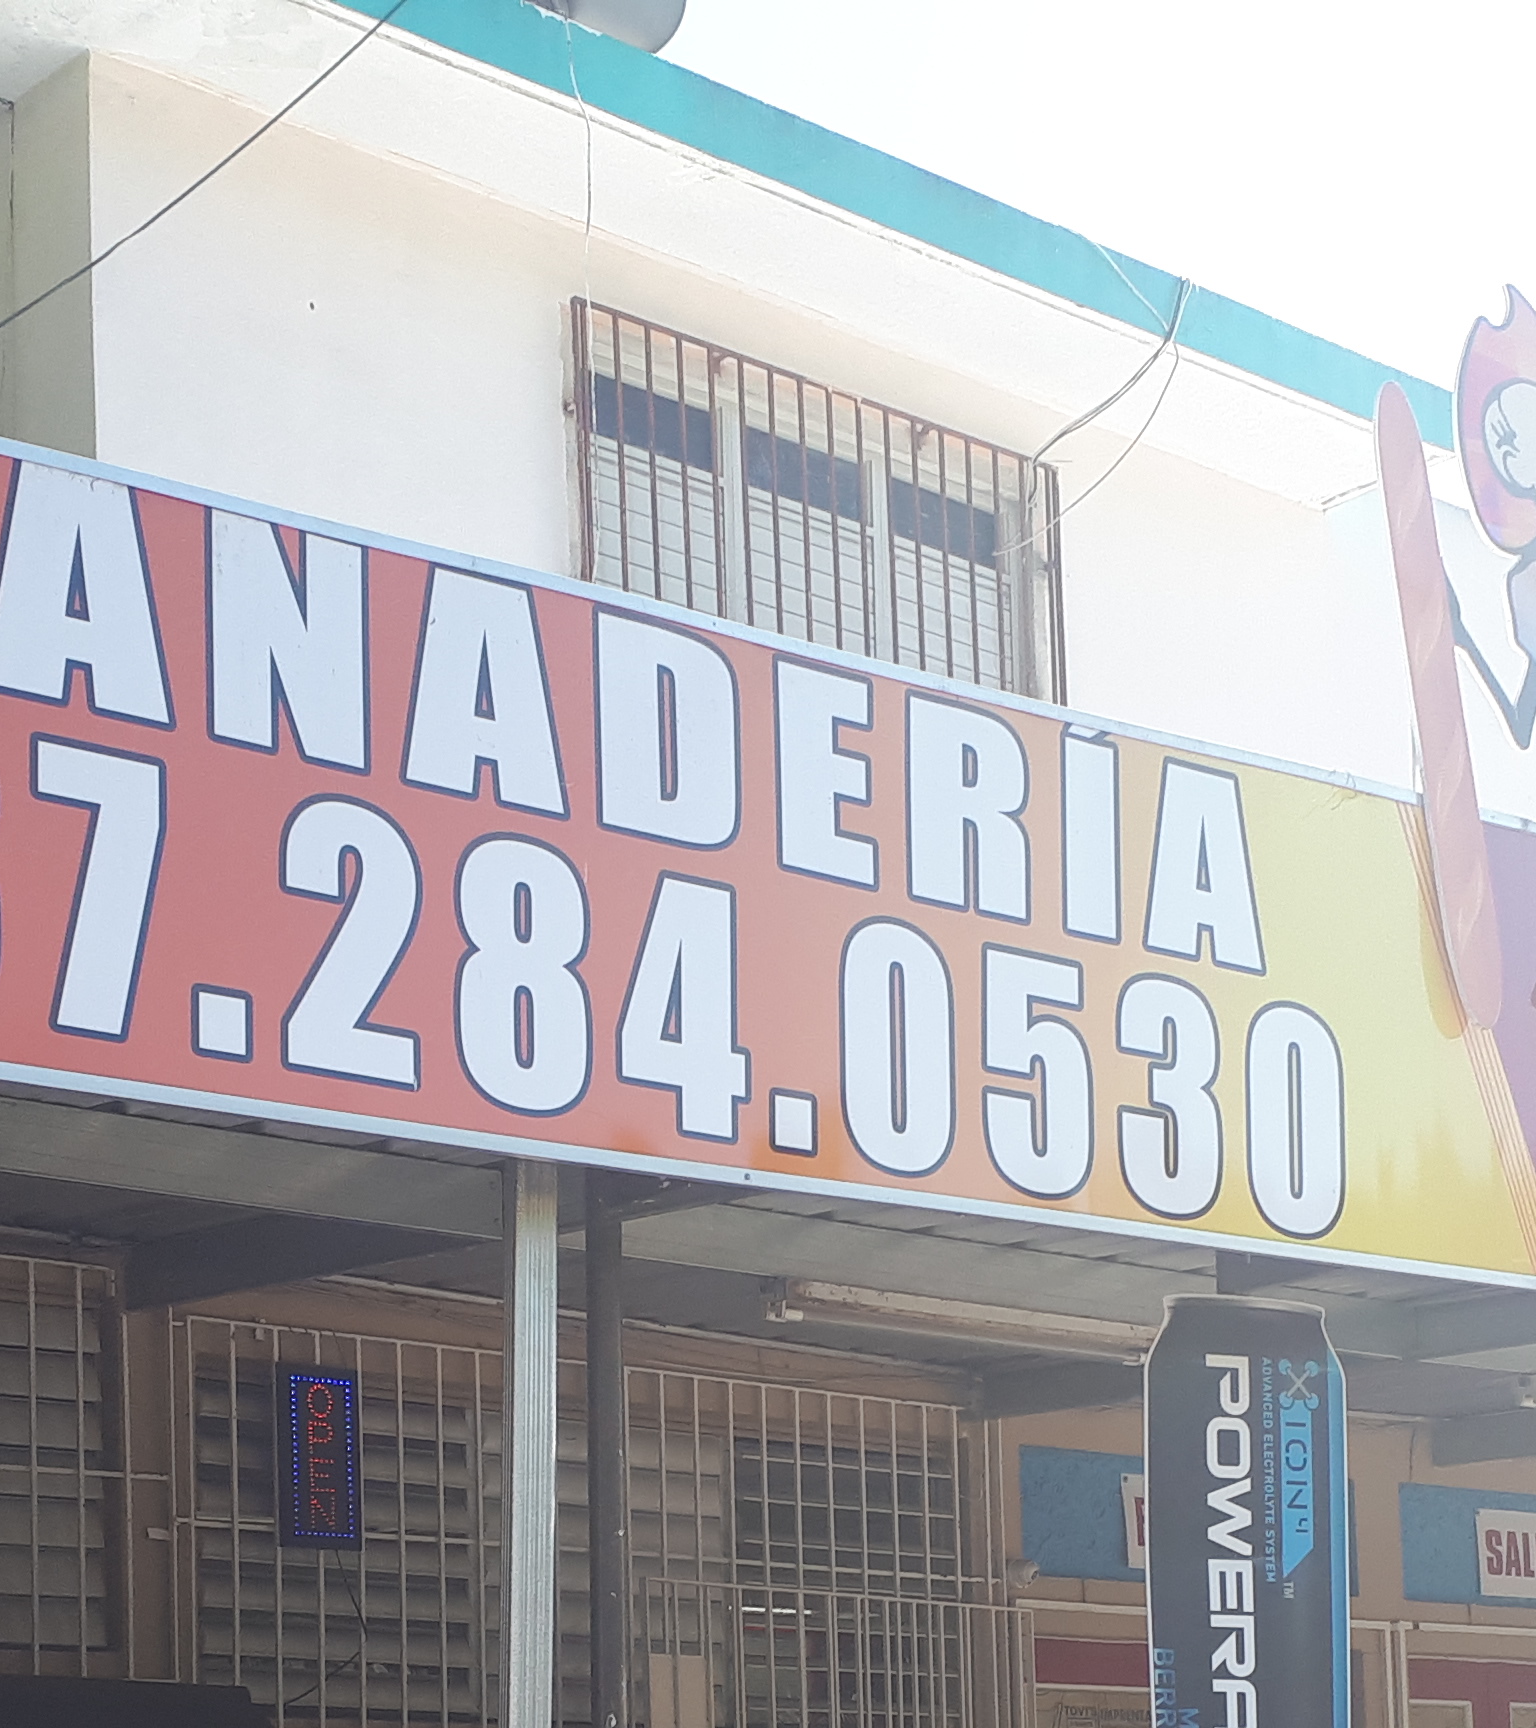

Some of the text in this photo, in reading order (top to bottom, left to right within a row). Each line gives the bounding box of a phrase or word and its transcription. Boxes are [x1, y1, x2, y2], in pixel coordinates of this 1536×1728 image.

[306, 1382, 337, 1530] OPEN
[1262, 1356, 1277, 1584] ADVANCED ELECTROLYTE SYSTEM
